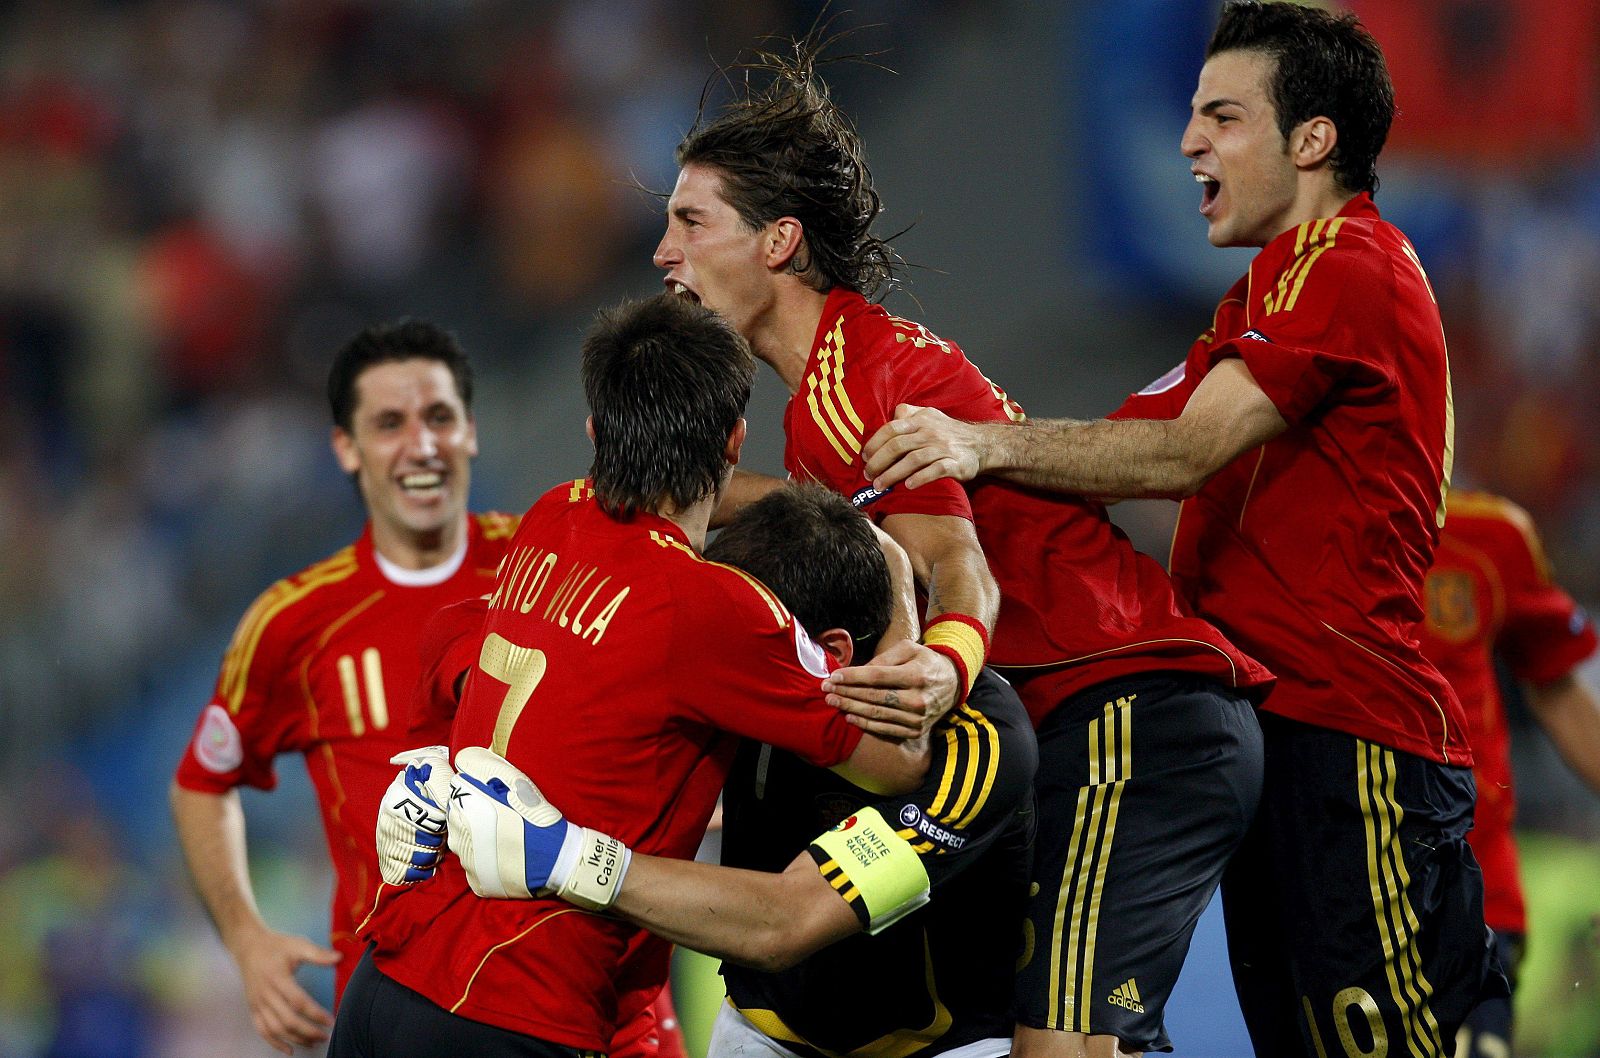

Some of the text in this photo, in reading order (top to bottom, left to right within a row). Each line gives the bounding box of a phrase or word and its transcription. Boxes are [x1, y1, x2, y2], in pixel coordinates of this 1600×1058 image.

[543, 560, 631, 646] VILLA
[336, 646, 390, 737] 11
[479, 632, 547, 758] 7
[853, 834, 880, 862] AGAINST
[862, 827, 891, 857] UNITE
[919, 818, 966, 849] RESPECT
[587, 838, 605, 867] Iker
[596, 836, 619, 887] Casilla
[846, 838, 872, 868] RACISM
[1107, 994, 1145, 1014] adidas
[1302, 986, 1389, 1058] 10
